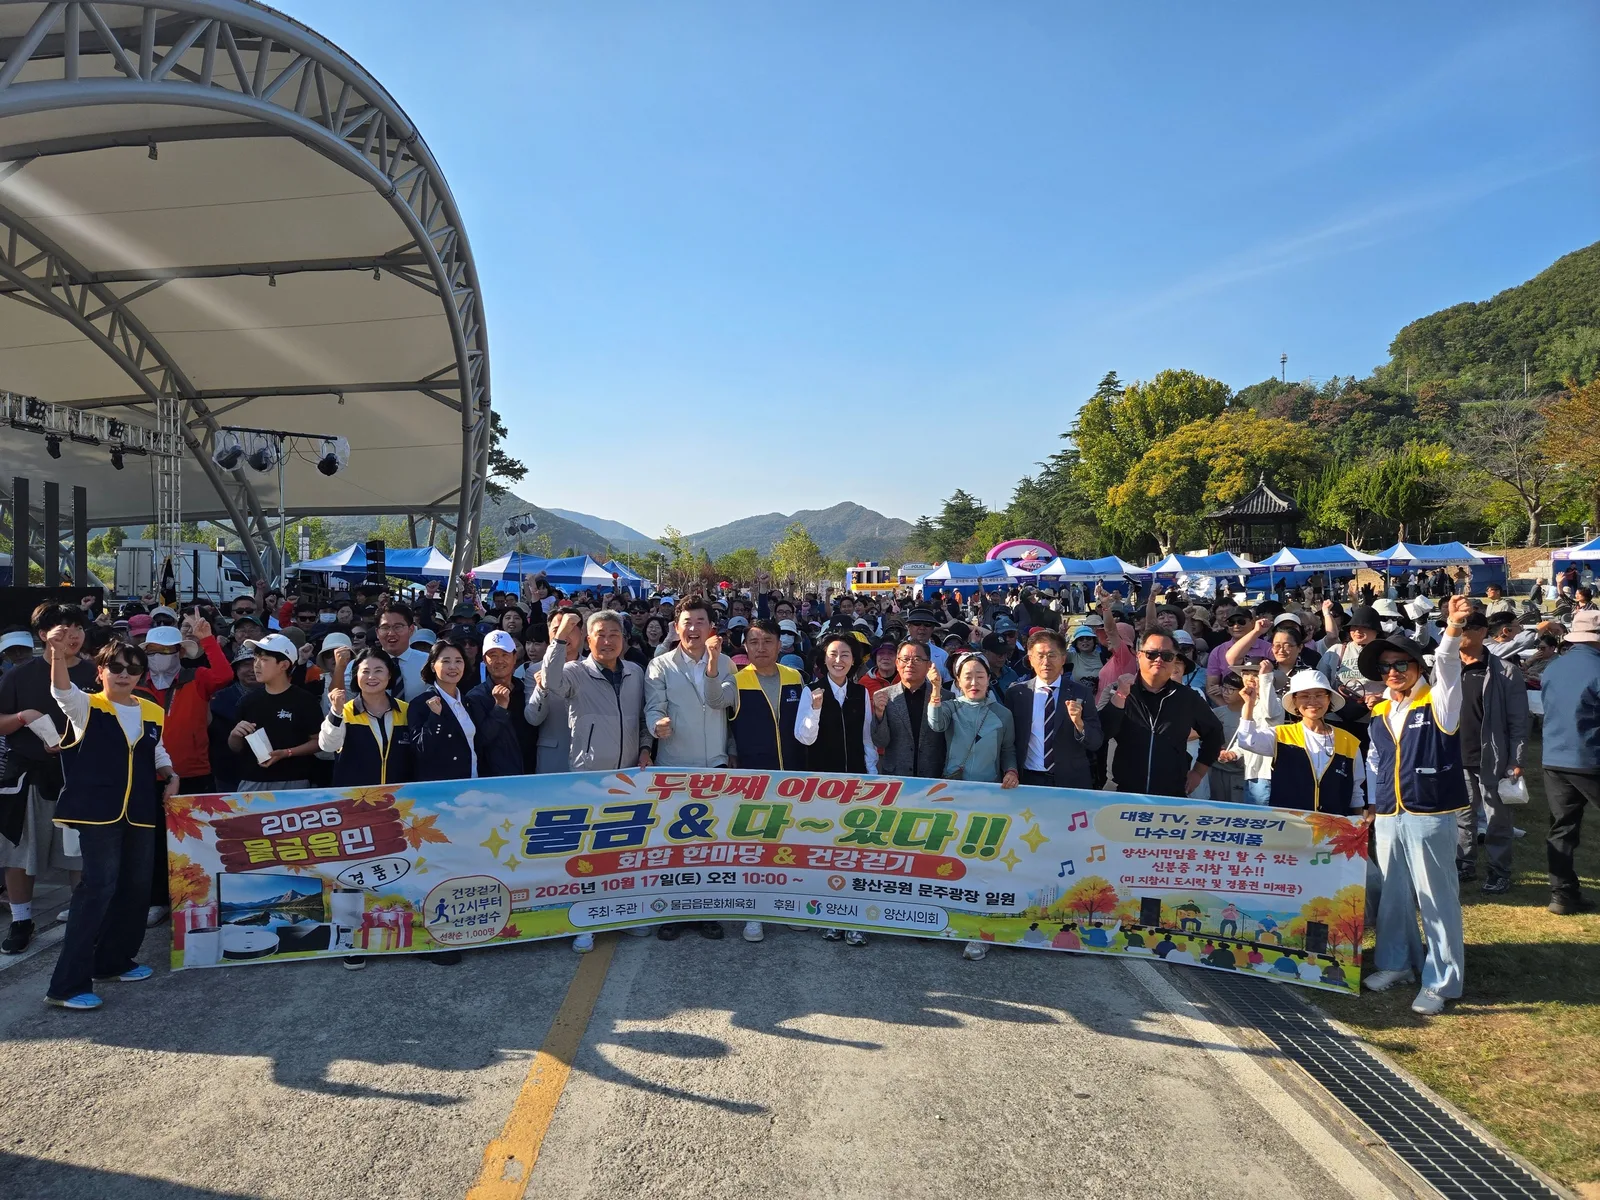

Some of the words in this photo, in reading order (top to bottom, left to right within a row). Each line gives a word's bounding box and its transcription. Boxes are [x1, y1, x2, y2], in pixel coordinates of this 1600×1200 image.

[647, 773, 770, 801] 두번째
[777, 775, 903, 805] 이야기
[260, 807, 343, 836] 2026
[524, 802, 656, 855] 물금
[668, 803, 714, 839] &
[1119, 811, 1154, 823] 대형
[1159, 813, 1189, 825] TV,
[1196, 815, 1286, 832] 공기청정기
[243, 826, 375, 864] 물금읍민
[1134, 827, 1187, 840] 다수의
[1191, 829, 1264, 847] 가전제품
[617, 848, 674, 870] 화합
[683, 845, 765, 865] 한마당
[772, 847, 796, 865] &
[807, 847, 915, 874] 건강걷기
[1122, 848, 1198, 861] 양산시민임을
[1203, 849, 1230, 861] 확인
[1236, 850, 1249, 863] 할
[1254, 852, 1267, 864] 수
[1273, 853, 1299, 866] 있는
[1195, 863, 1223, 875] 지참
[1228, 864, 1264, 877] 필수!!
[452, 884, 501, 900] 건강걷기
[535, 881, 596, 898] 2026년
[601, 876, 635, 893] 10월
[640, 872, 702, 889] 17일(토)
[706, 871, 736, 885] 오전
[742, 872, 787, 886] 10:00
[852, 877, 913, 896] 황산공원
[918, 882, 979, 903] 문주광장
[985, 891, 1015, 906] 일원
[1119, 875, 1135, 885] (미
[1138, 876, 1169, 886] 지참시
[1174, 877, 1206, 888] 도시락
[1211, 878, 1222, 889] 및
[1226, 879, 1259, 891] 경품권
[451, 896, 502, 915] 12시부터
[671, 898, 756, 911] 물금읍문화체육회
[774, 898, 795, 912] 후원
[826, 902, 858, 917] 양산시
[884, 907, 939, 924] 양산시의회
[452, 911, 501, 927] 신청접수
[440, 931, 463, 941] 선착순
[466, 927, 495, 938] 1,000명
